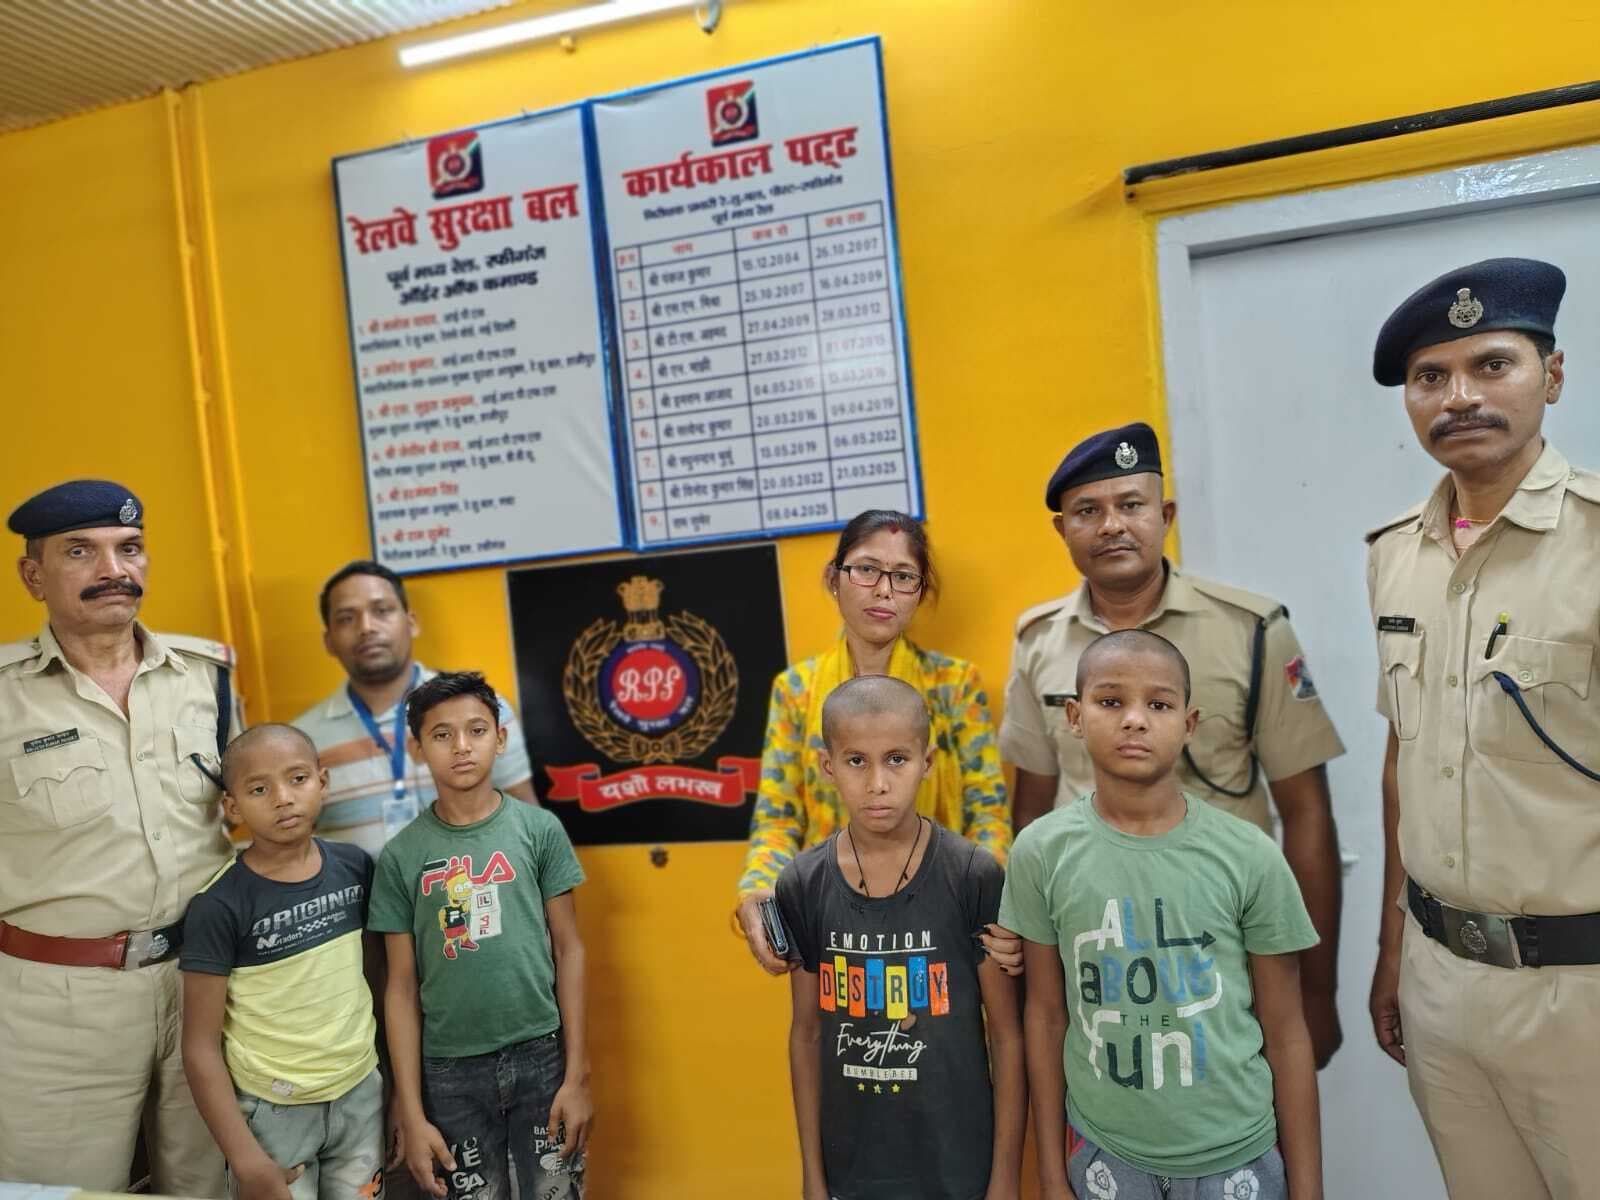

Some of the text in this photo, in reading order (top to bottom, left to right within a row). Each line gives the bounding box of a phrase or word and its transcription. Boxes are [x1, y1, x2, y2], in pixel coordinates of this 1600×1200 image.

[622, 144, 772, 198] कार्यकाल
[347, 184, 579, 255] रेलवे सुरक्षा बल
[386, 265, 409, 289] पूर्व
[414, 262, 447, 279] मध्य
[830, 931, 931, 950] EMOTION
[1097, 896, 1216, 953] ALL
[822, 967, 945, 1005] DESTROY
[1119, 1015, 1170, 1026] THE
[837, 1022, 927, 1065] Everything
[845, 1066, 913, 1079] BUMBLEBEE
